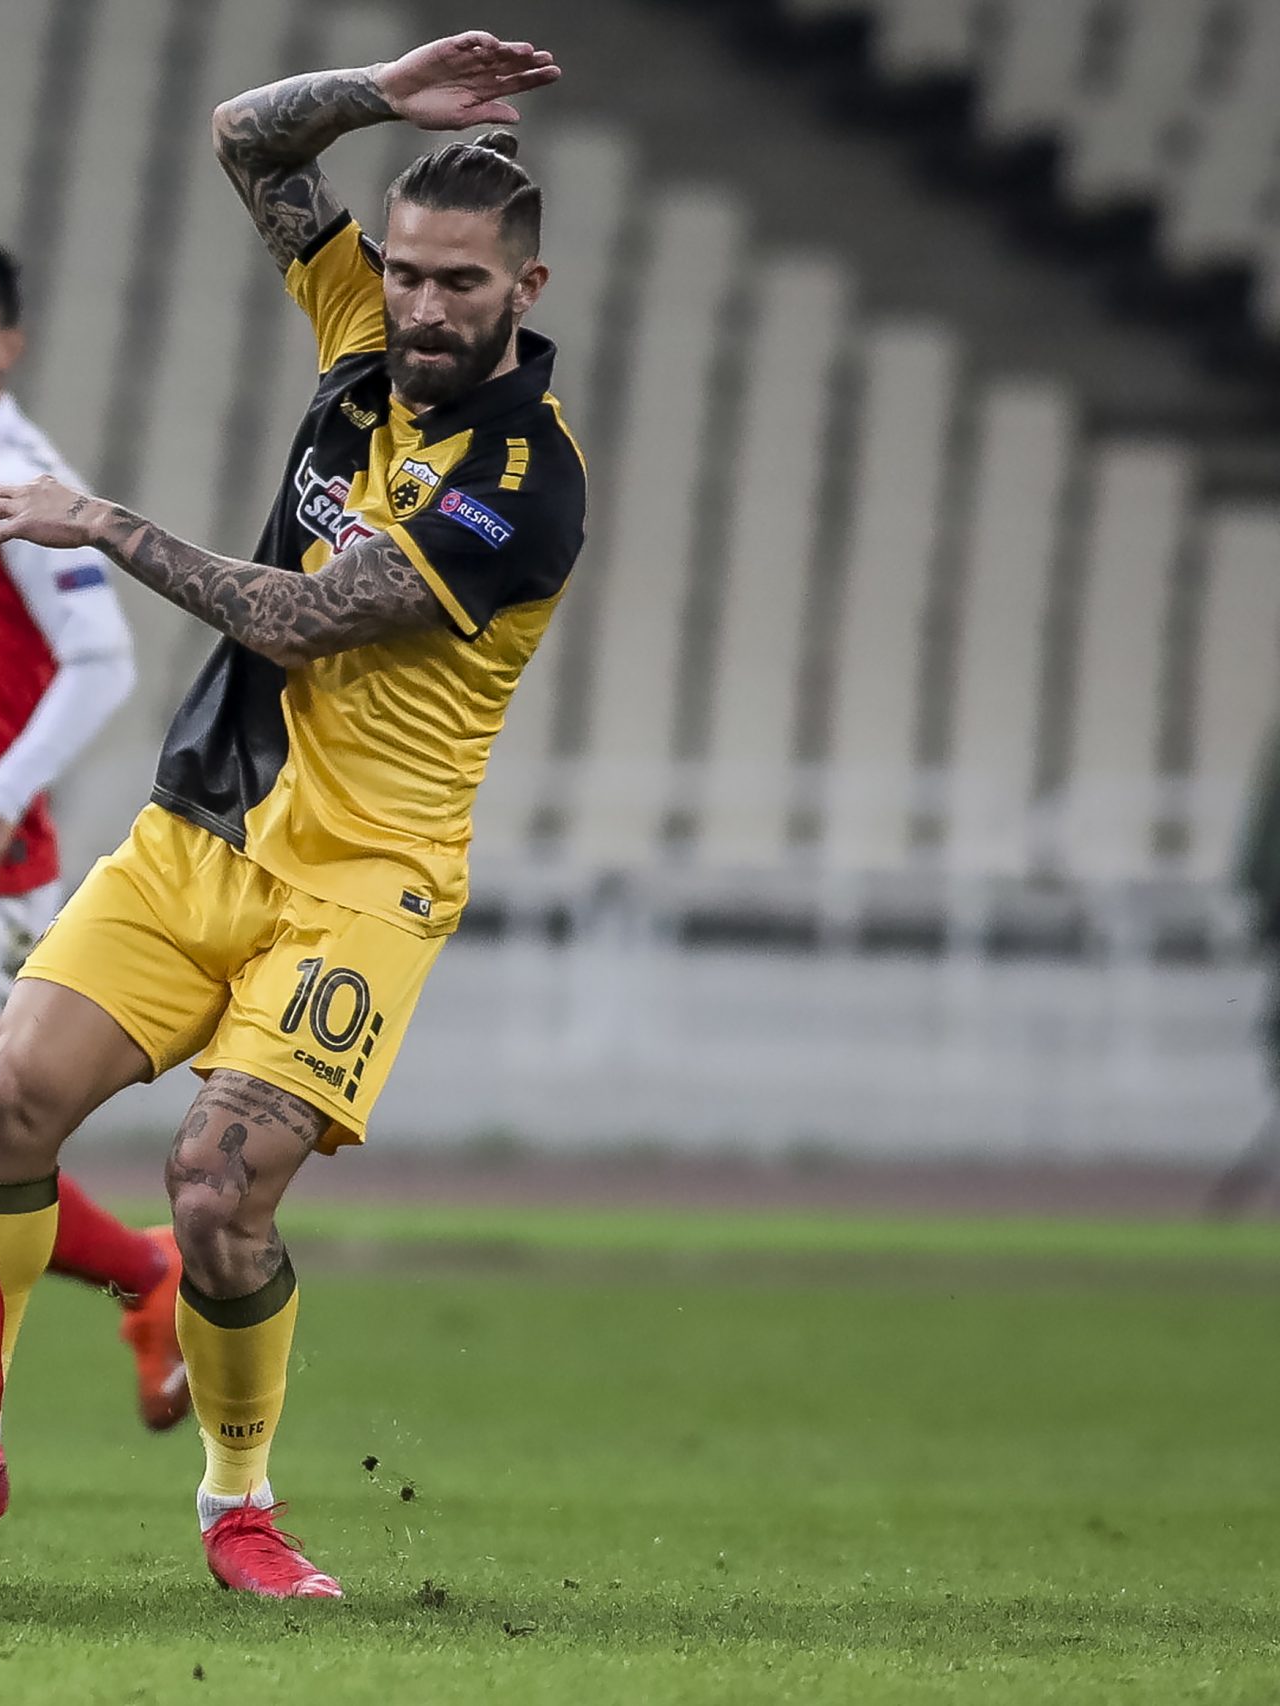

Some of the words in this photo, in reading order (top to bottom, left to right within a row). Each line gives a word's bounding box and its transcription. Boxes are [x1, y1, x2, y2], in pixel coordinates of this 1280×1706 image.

[456, 502, 511, 543] RESPECT
[279, 956, 371, 1053] 10
[293, 1049, 347, 1088] capelli
[220, 1422, 246, 1438] AEK
[249, 1420, 265, 1437] FC
